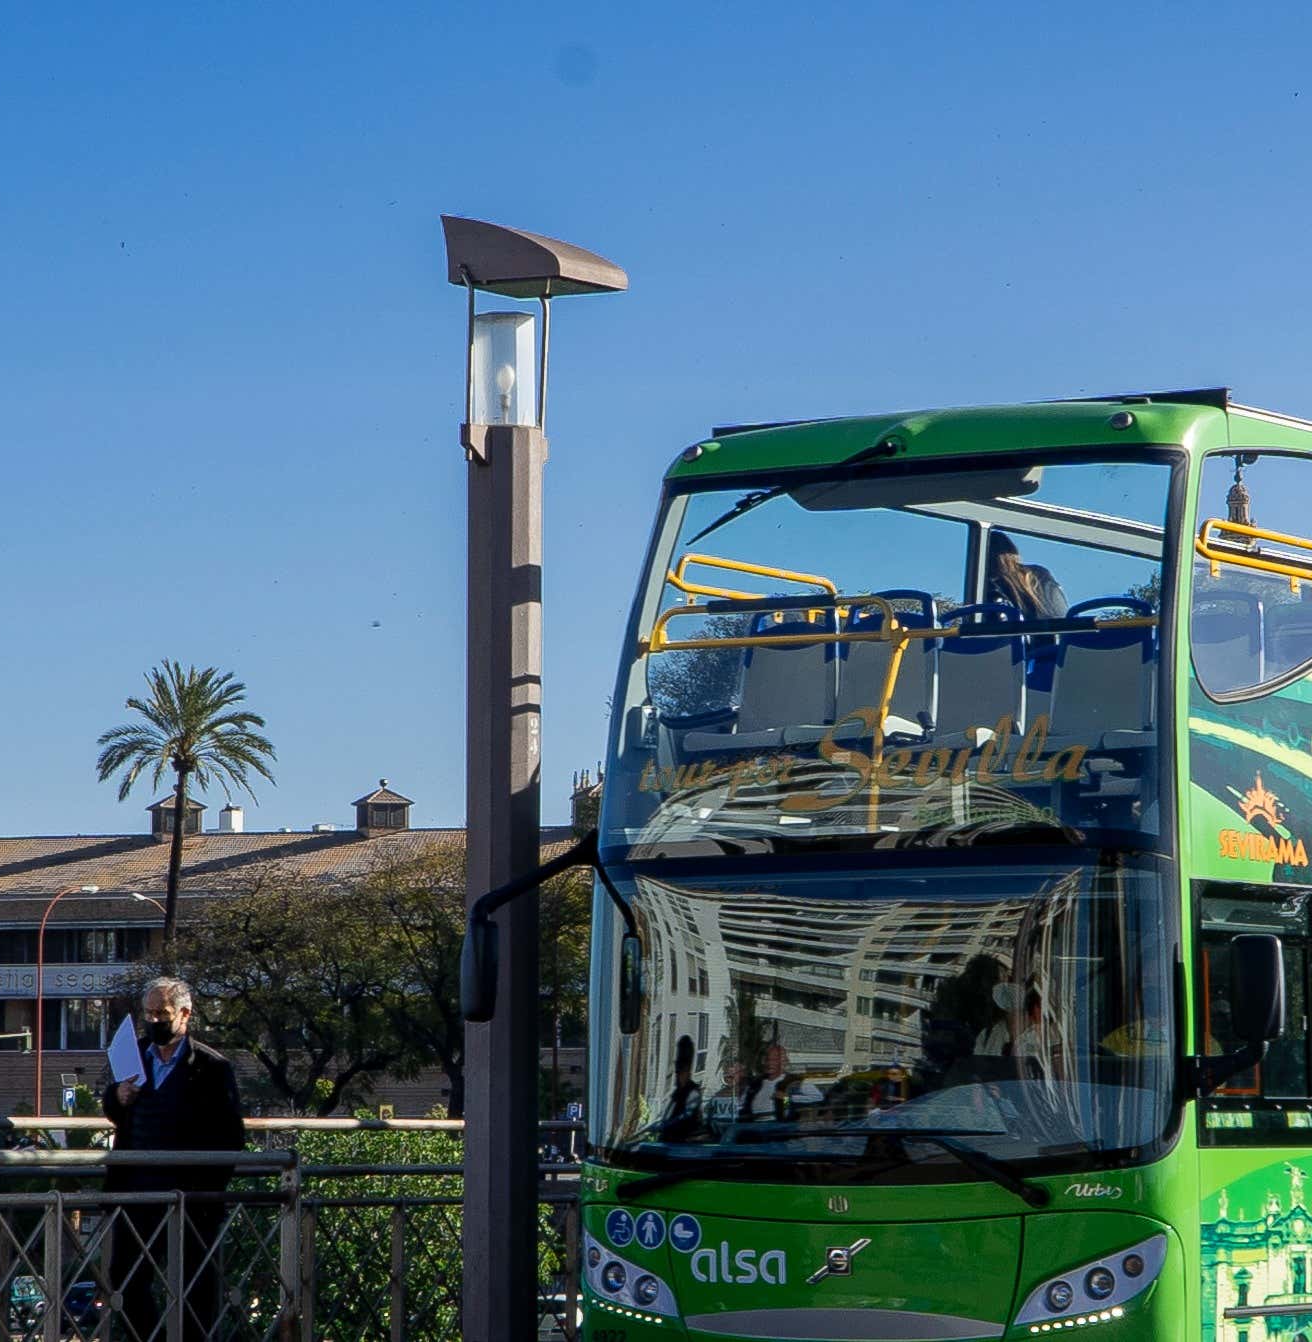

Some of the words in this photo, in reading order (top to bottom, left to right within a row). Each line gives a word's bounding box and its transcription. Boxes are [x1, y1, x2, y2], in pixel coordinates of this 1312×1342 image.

[778, 707, 1089, 812] Sevilla
[1218, 828, 1309, 867] SEVIRAMA
[690, 1240, 787, 1284] alsa
